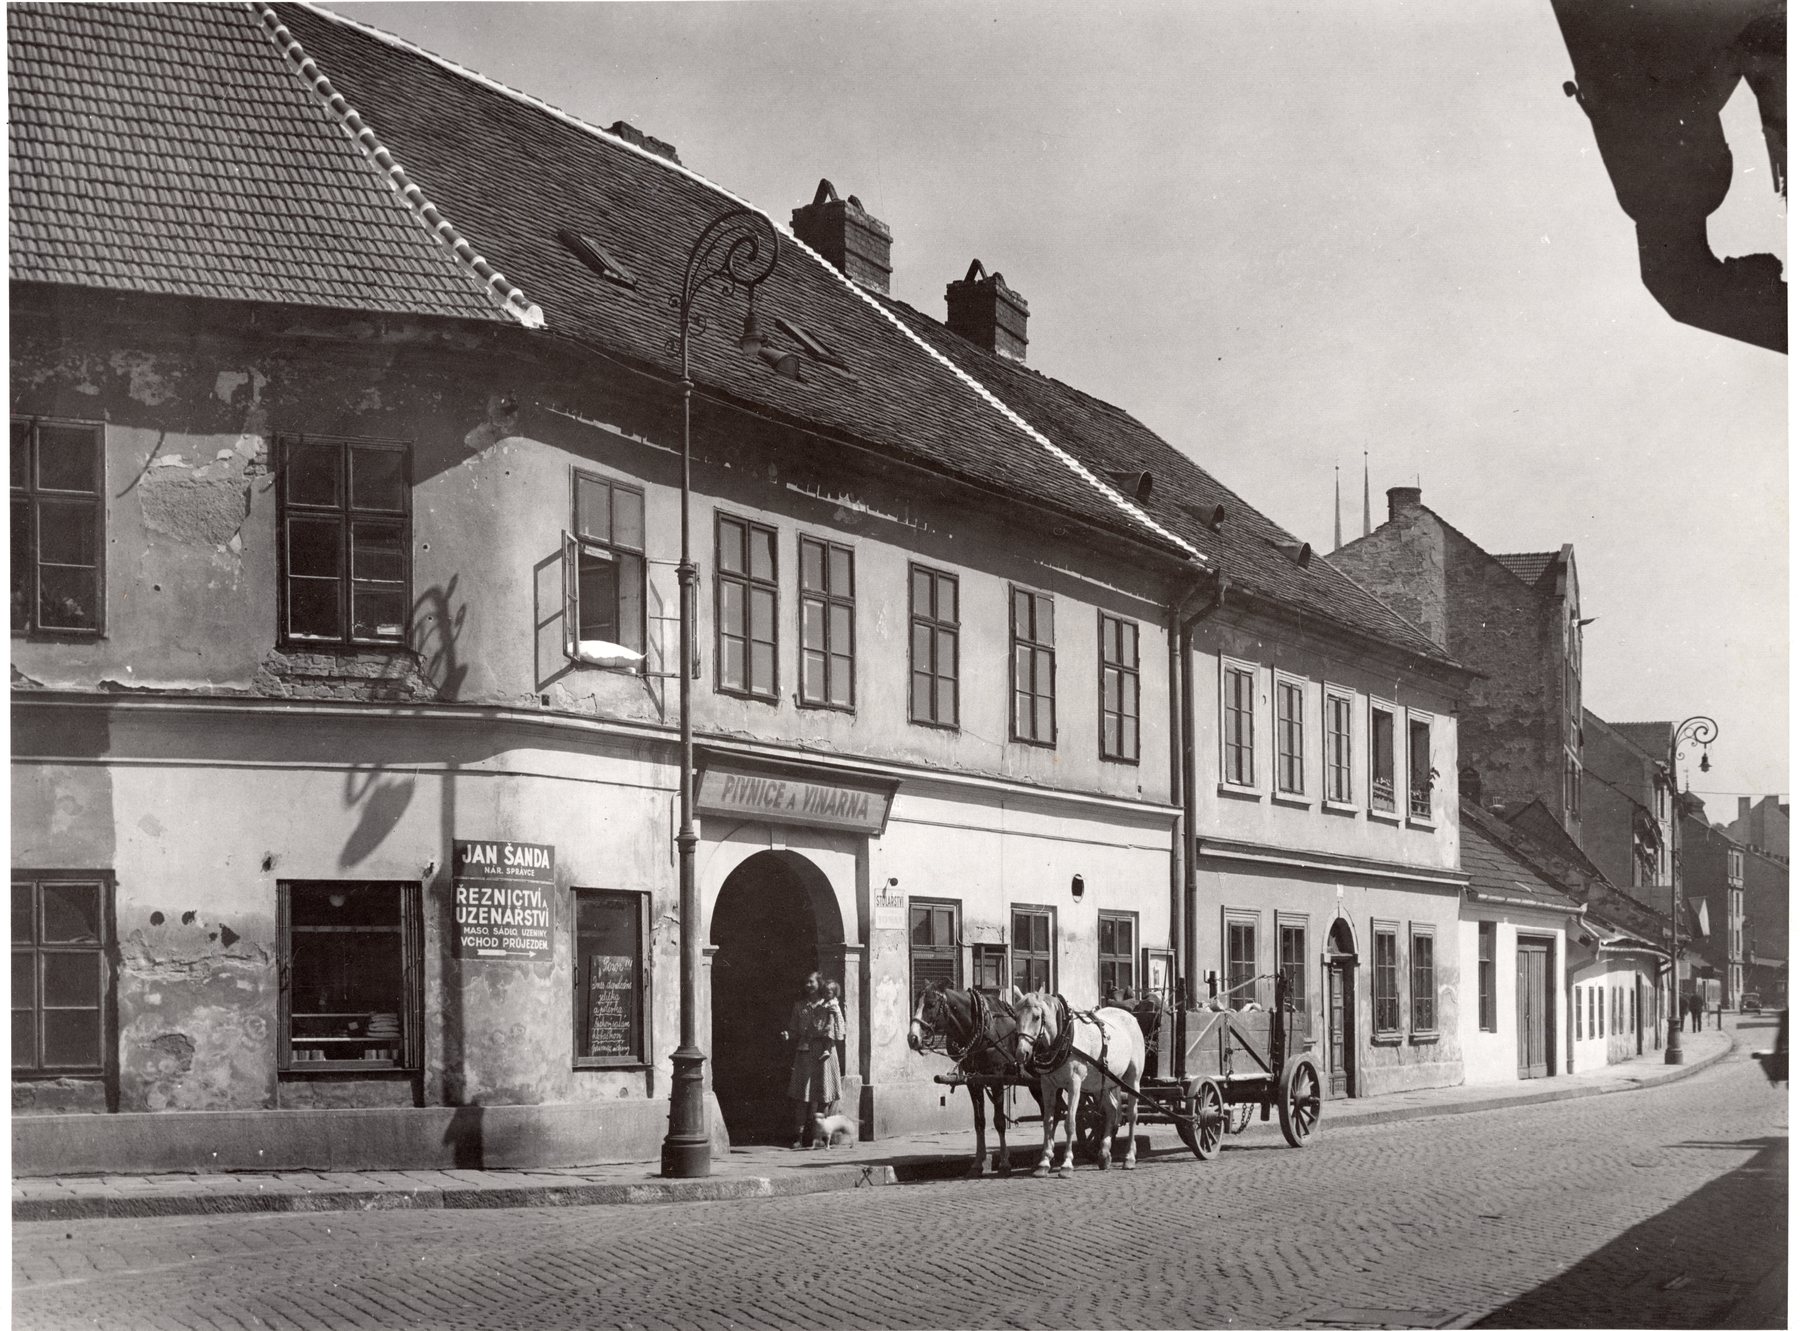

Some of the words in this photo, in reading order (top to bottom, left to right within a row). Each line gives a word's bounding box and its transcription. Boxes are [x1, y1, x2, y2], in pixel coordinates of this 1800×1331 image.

[721, 775, 786, 808] PIVNICE
[462, 844, 497, 864] JAN
[504, 842, 550, 869] ŠANDA
[456, 884, 541, 907] ŘEZNICTVÍ
[456, 905, 549, 927] UZENÁŘSTVÍ
[460, 936, 499, 947] VCHOD
